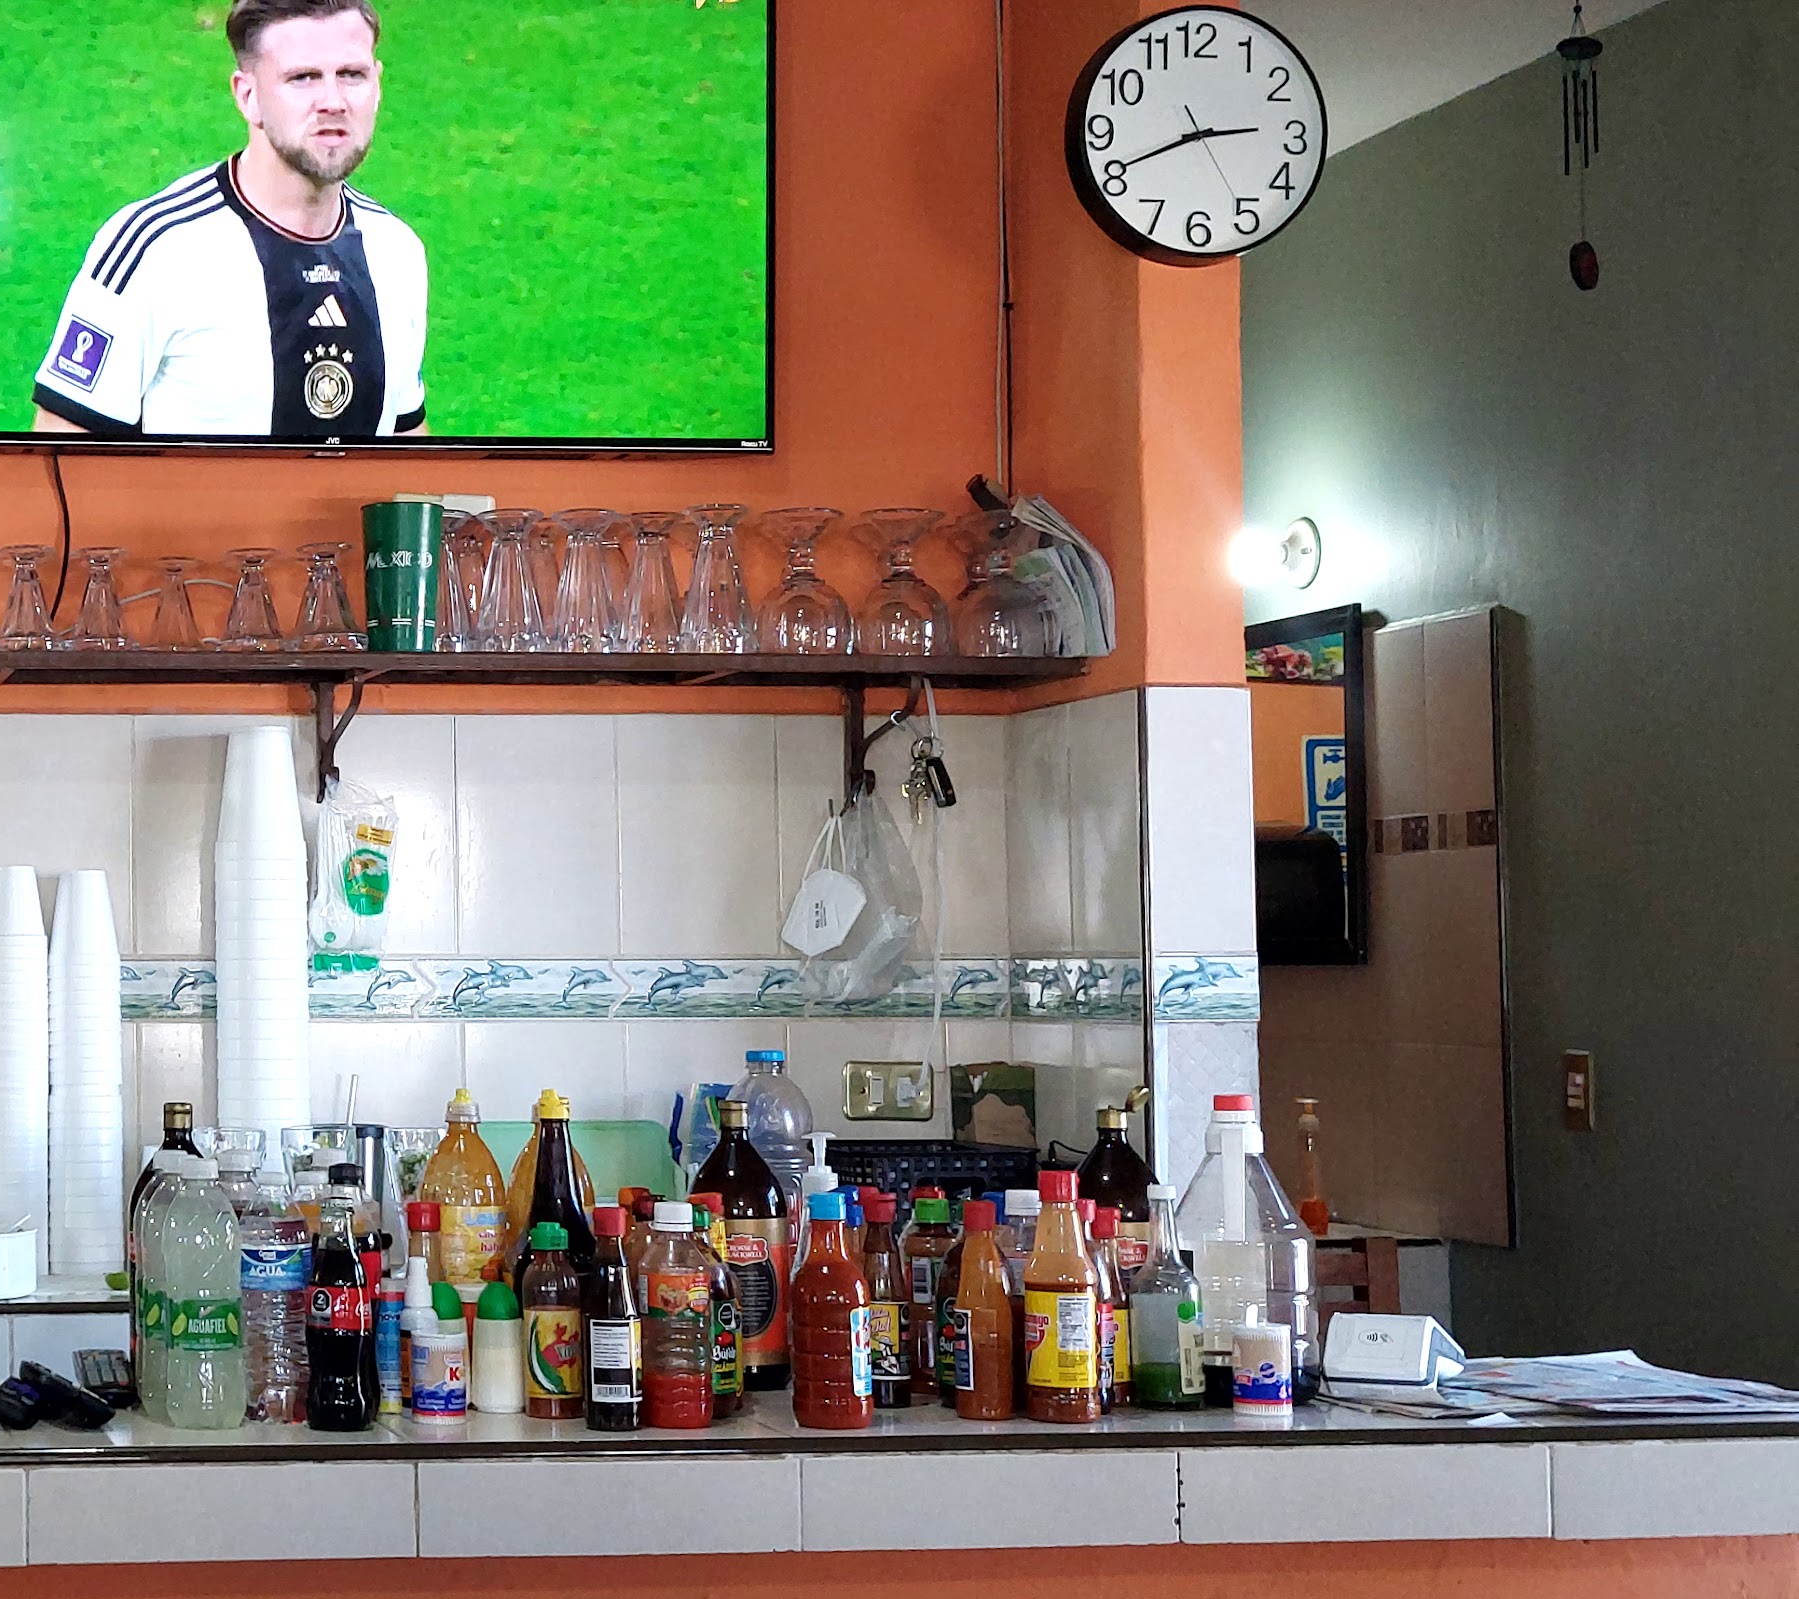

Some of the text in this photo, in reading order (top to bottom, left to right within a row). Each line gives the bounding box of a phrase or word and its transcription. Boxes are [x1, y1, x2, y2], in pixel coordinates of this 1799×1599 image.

[1138, 32, 1169, 71] 11
[1175, 20, 1218, 59] 12
[1238, 36, 1253, 74] 1
[1101, 68, 1145, 106] 10
[1266, 66, 1292, 103] 2
[1087, 114, 1115, 151] 9
[1283, 120, 1308, 156] 3
[1102, 159, 1128, 197] 8
[1268, 161, 1296, 201] 4
[1138, 198, 1166, 236] 7
[1185, 211, 1212, 248] 6
[1233, 197, 1260, 235] 5
[325, 437, 341, 445] JVC
[248, 1265, 284, 1278] AGUA
[316, 1293, 326, 1305] 2
[187, 1318, 228, 1334] AGUAFIEL
